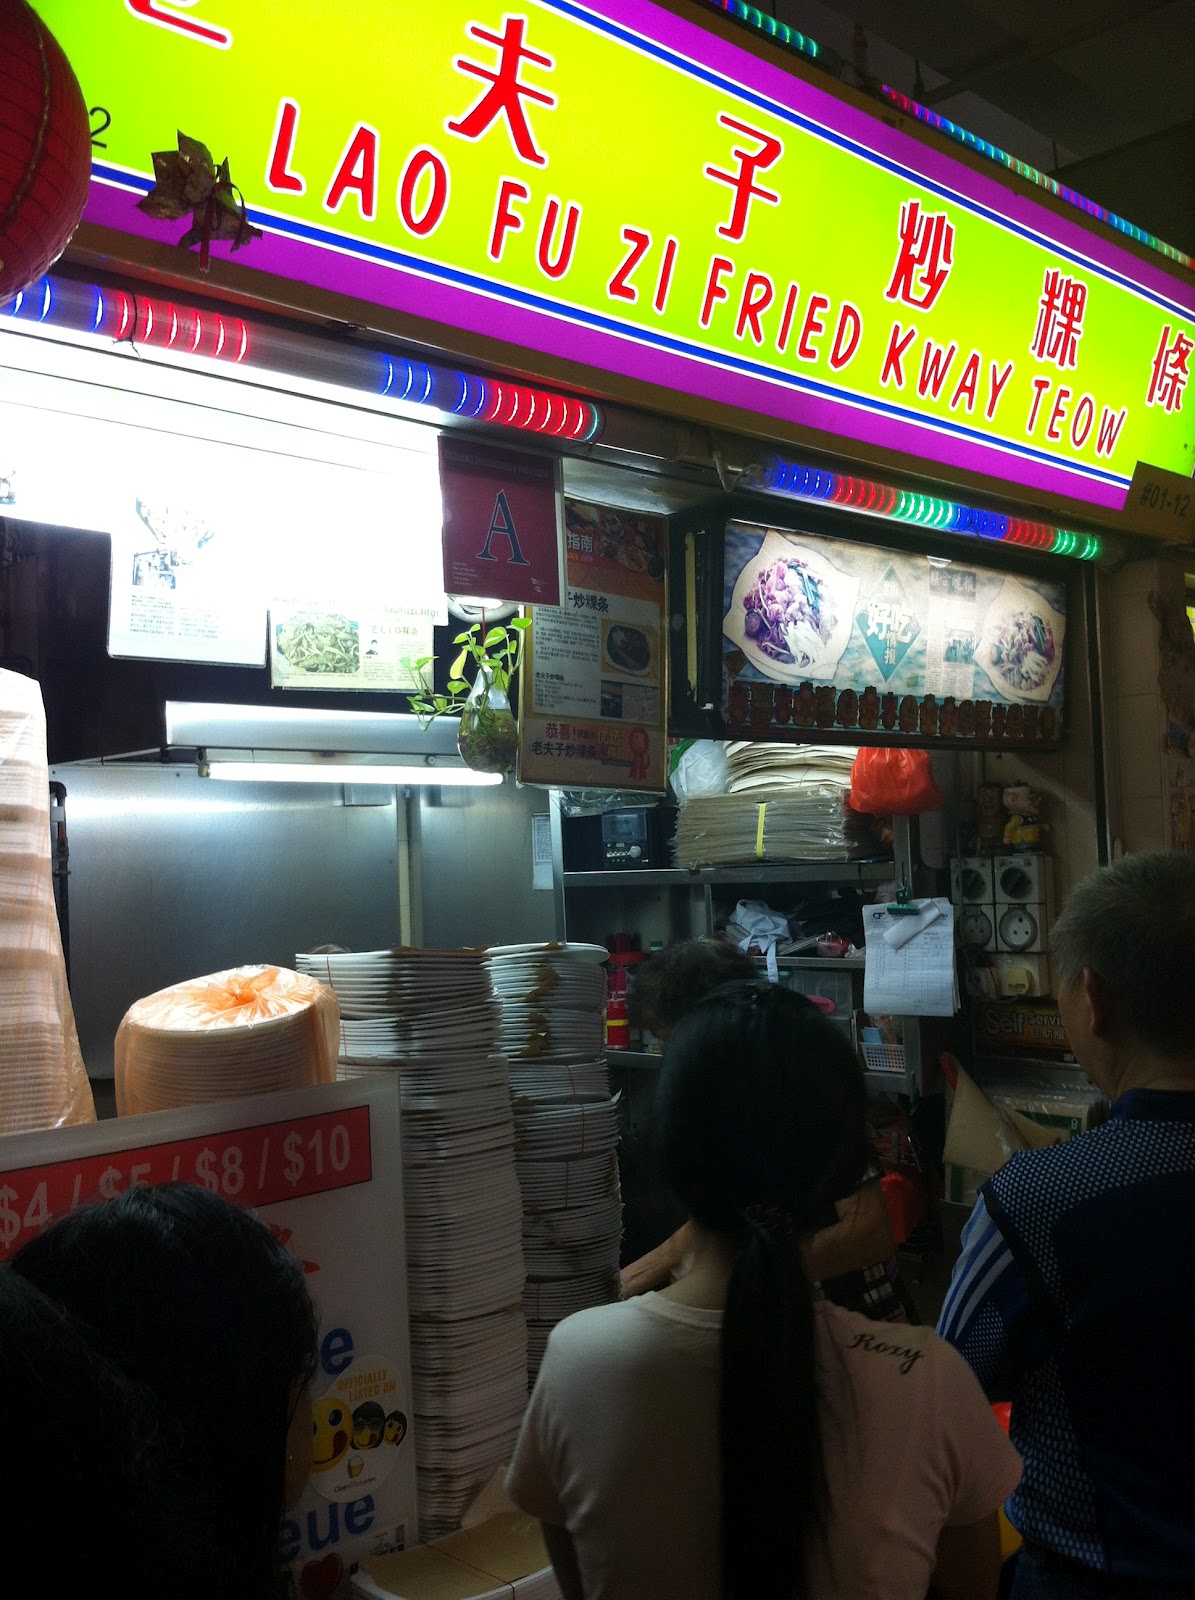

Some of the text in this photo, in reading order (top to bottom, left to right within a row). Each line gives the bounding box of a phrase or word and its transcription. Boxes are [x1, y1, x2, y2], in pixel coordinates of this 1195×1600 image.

[269, 103, 1127, 454] LAO FU ZI FRIED KWAY TEOW
[475, 488, 531, 566] A
[983, 1007, 1024, 1035] Self
[195, 1145, 245, 1196] $8
[282, 1124, 351, 1188] $10
[847, 1333, 925, 1375] Roxy
[337, 1368, 388, 1392] OFFICIALLY
[348, 1385, 379, 1403] LISTED
